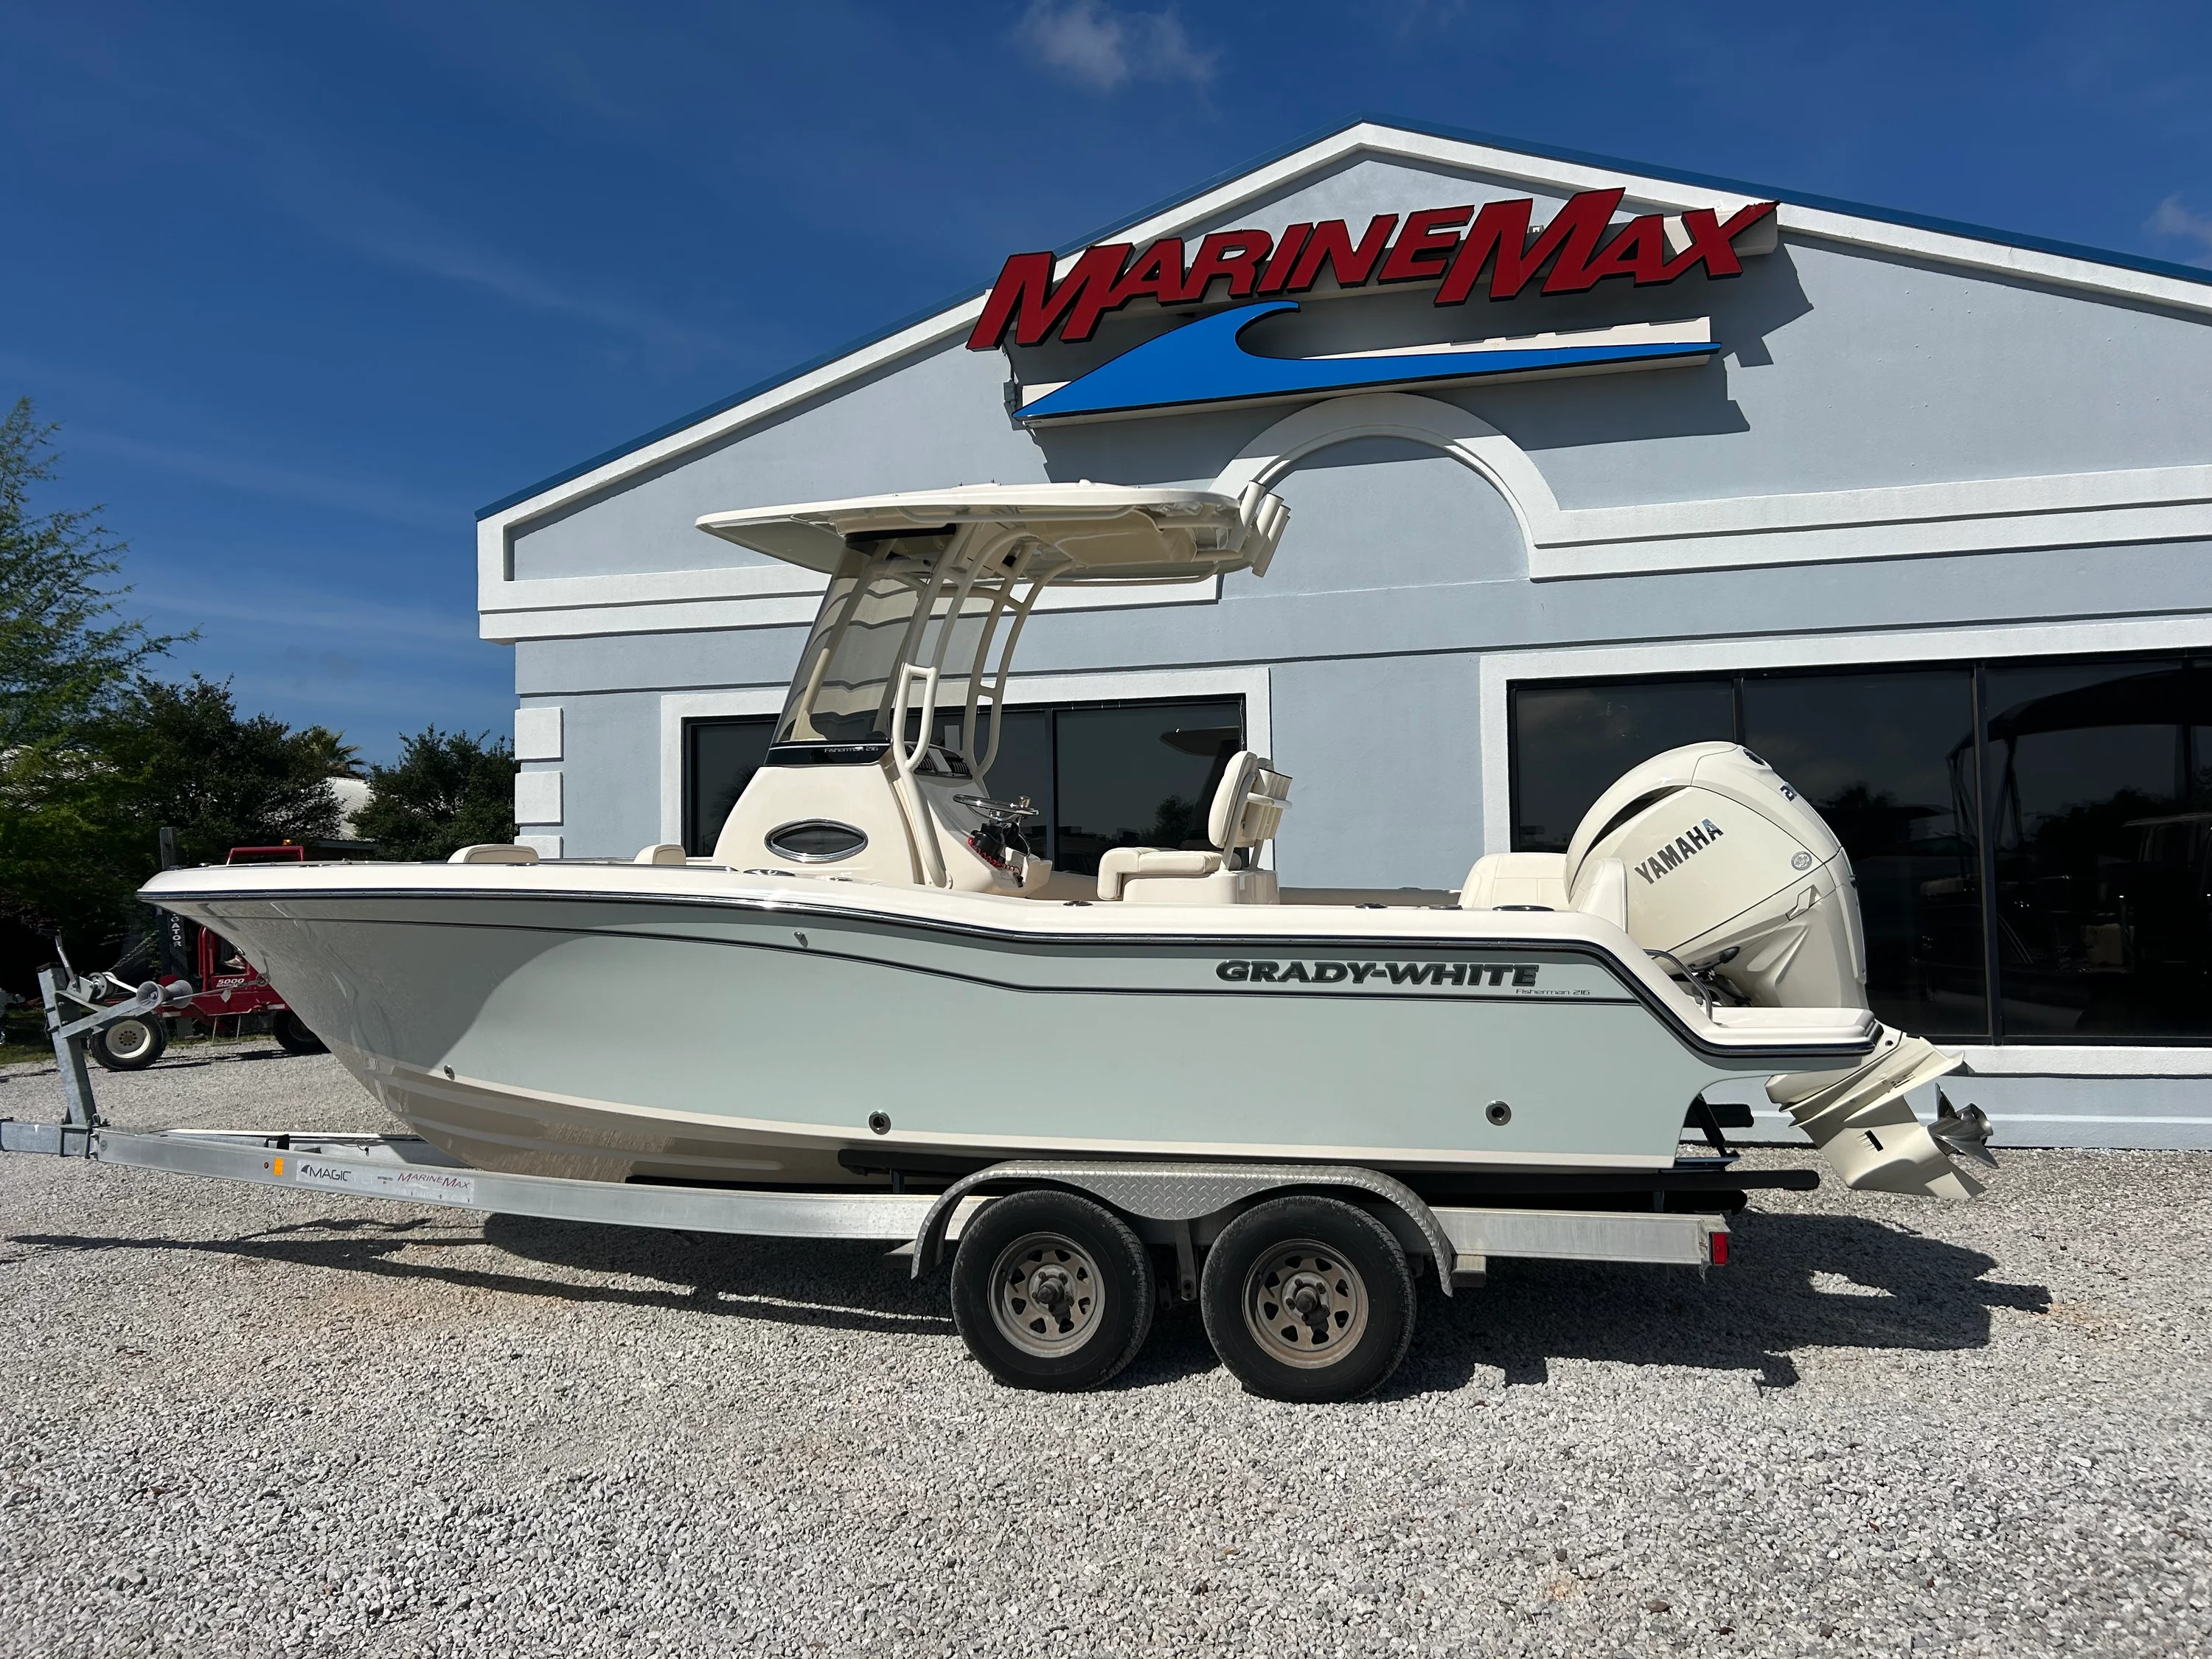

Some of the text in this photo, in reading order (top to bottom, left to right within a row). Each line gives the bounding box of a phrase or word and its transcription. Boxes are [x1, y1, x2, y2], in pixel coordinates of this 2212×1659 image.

[966, 187, 1781, 351] MARINEMAX
[1634, 818, 1725, 885] YAMAHA
[170, 914, 182, 947] GATOR
[1216, 959, 1540, 987] GRADY-WHITE
[309, 1166, 352, 1182] MAGIC
[398, 1172, 470, 1189] MARINEMAX
